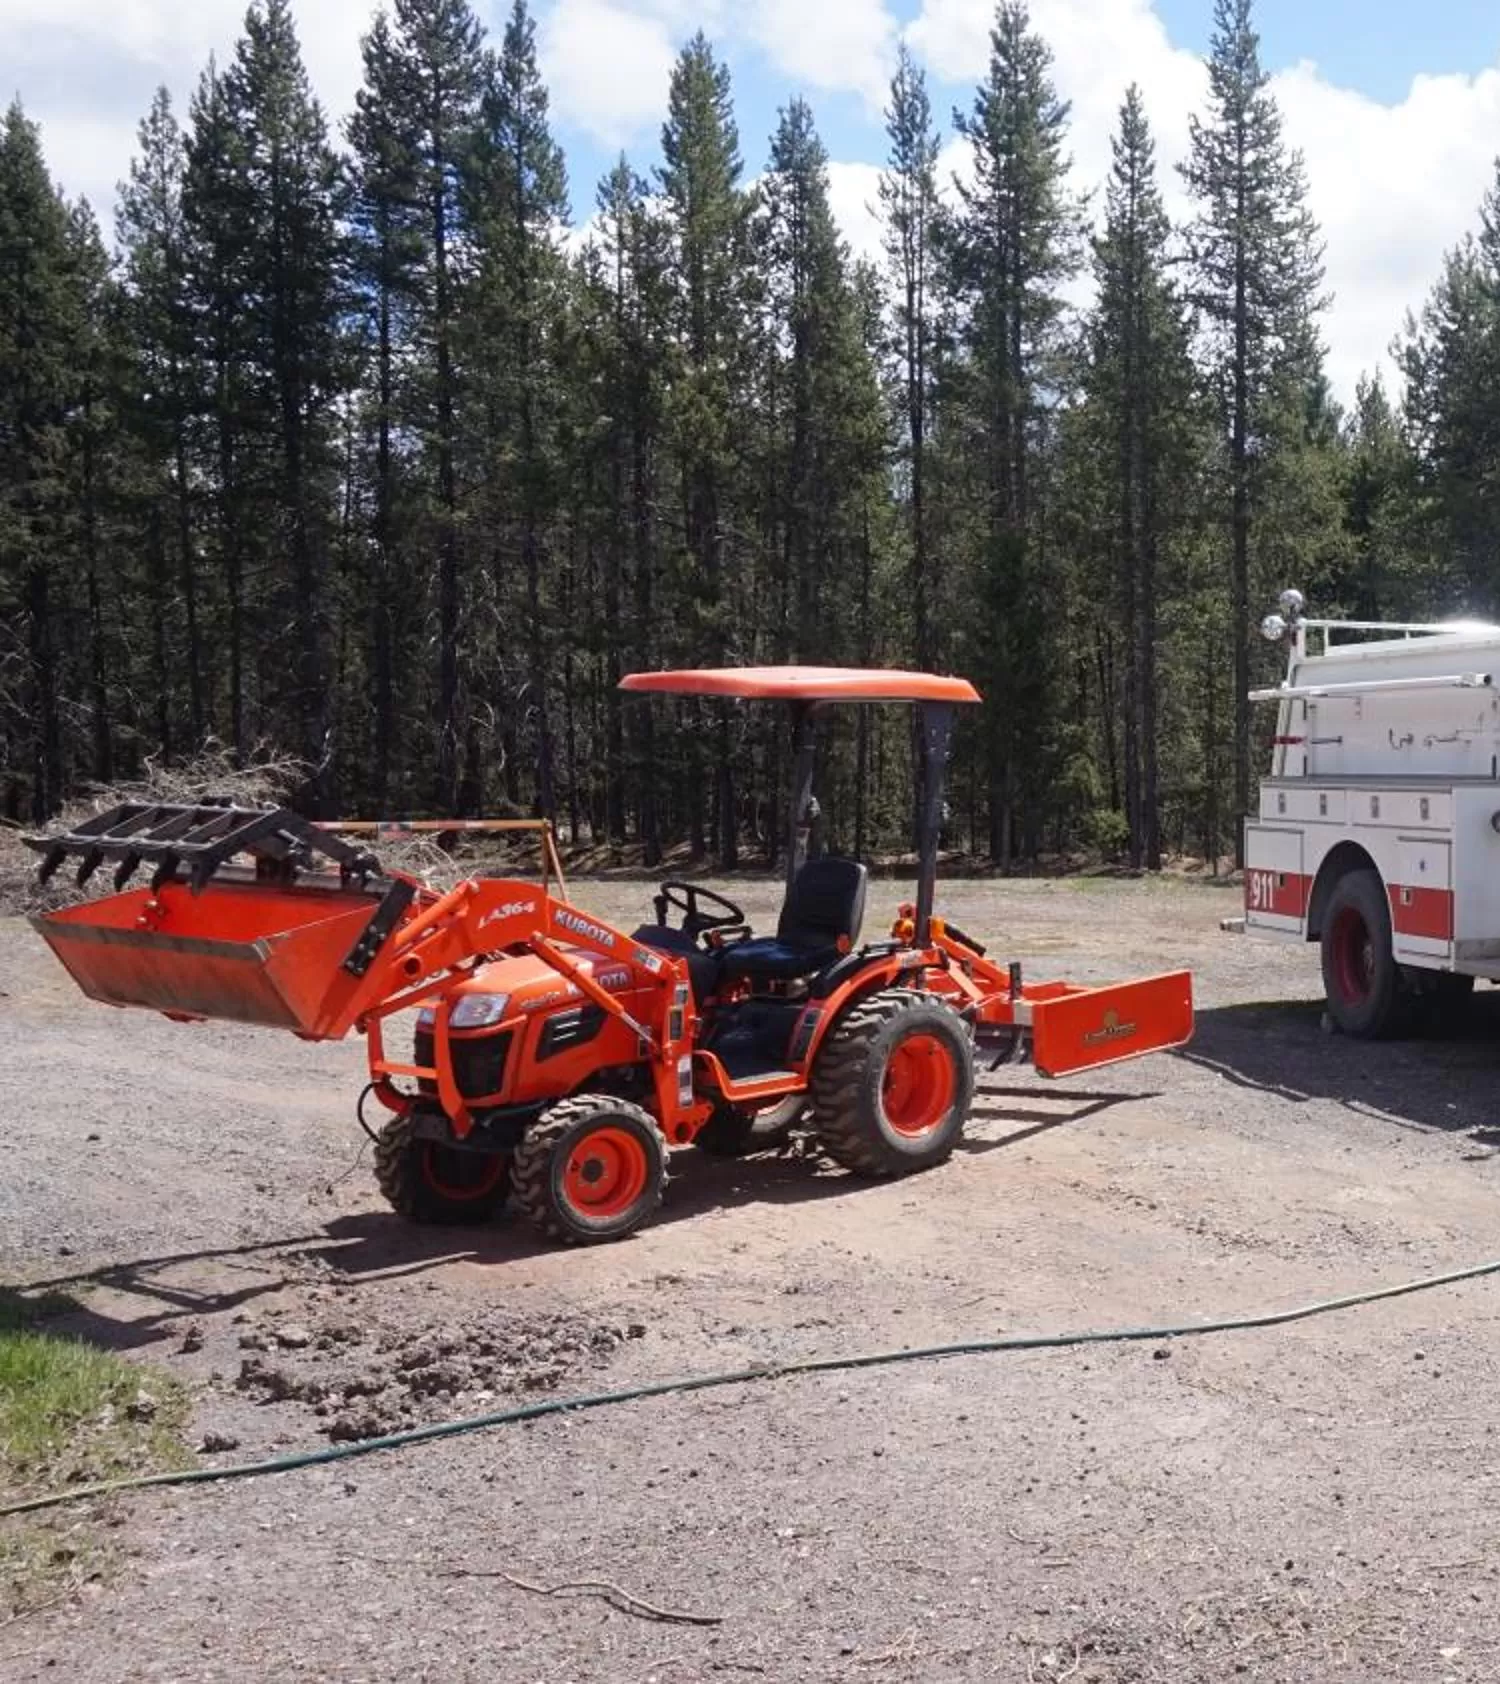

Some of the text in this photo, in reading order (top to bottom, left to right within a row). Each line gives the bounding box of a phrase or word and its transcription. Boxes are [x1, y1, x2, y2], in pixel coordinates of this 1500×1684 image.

[1250, 871, 1274, 909] 911
[477, 901, 537, 930] LA364
[554, 908, 617, 948] KUBOTA
[565, 970, 628, 996] KOTA
